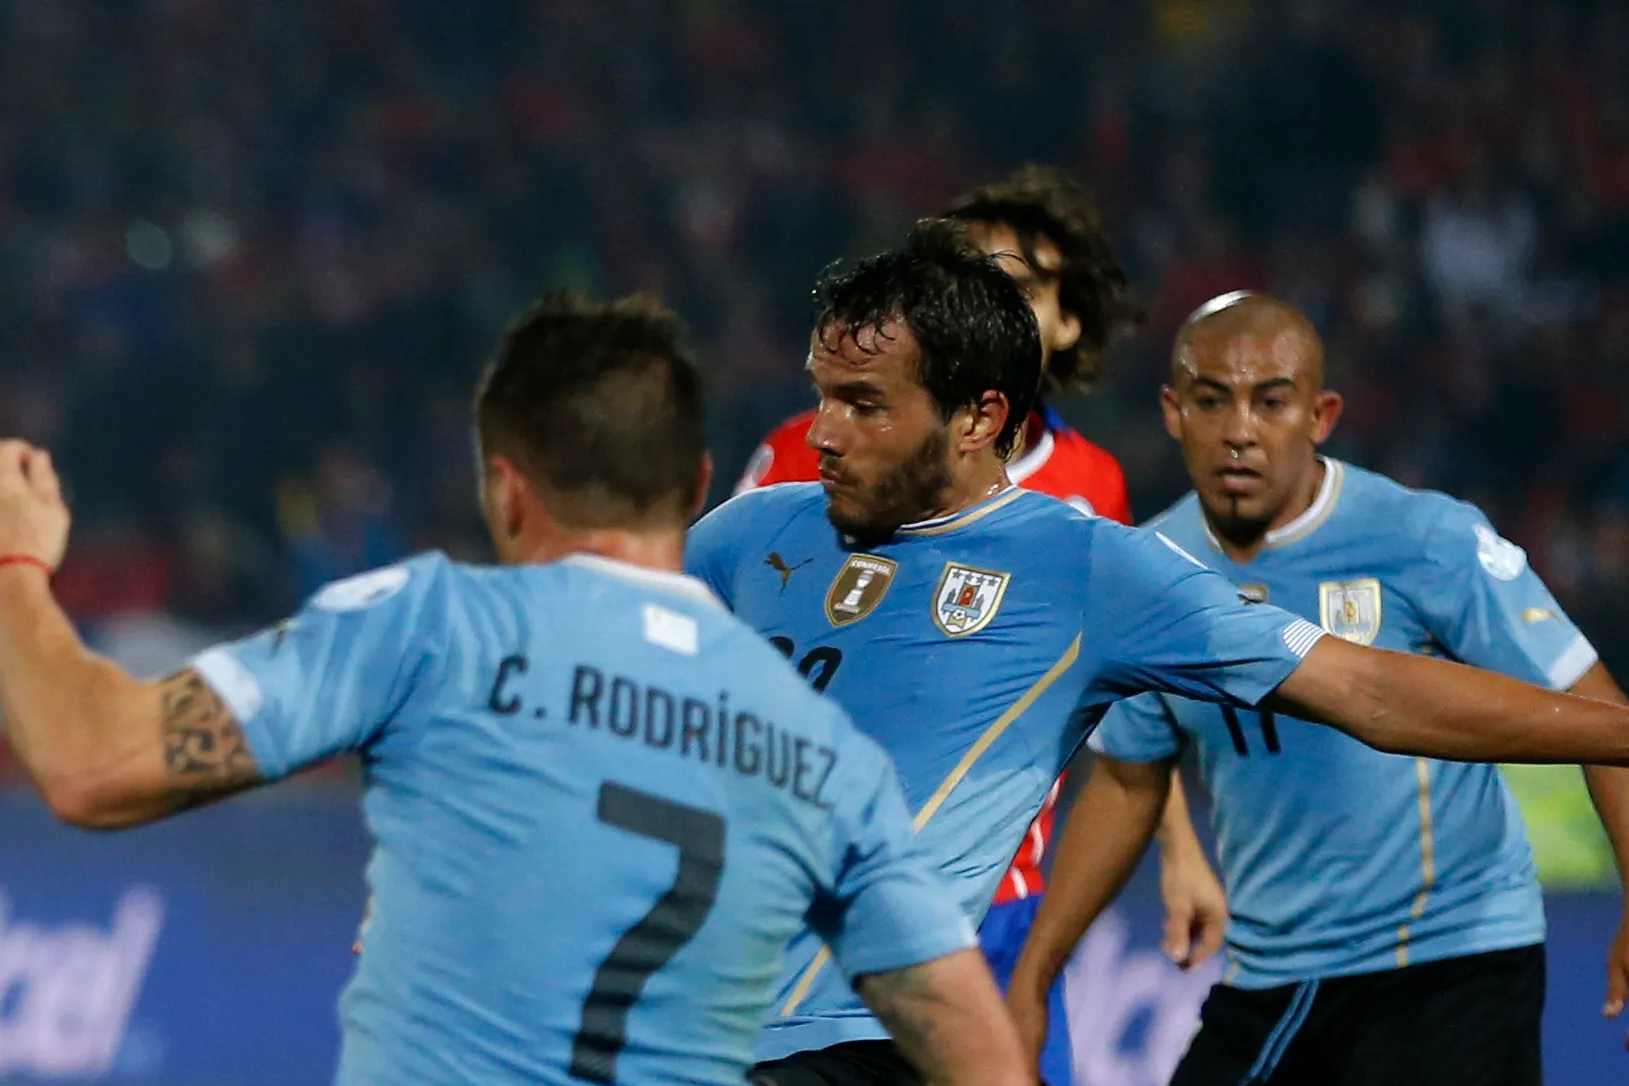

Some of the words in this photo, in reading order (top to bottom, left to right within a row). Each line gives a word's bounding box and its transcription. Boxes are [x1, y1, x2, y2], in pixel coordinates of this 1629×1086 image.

[488, 655, 546, 715] C.
[569, 664, 838, 810] RODRÍGUEZ
[568, 778, 727, 1086] 7
